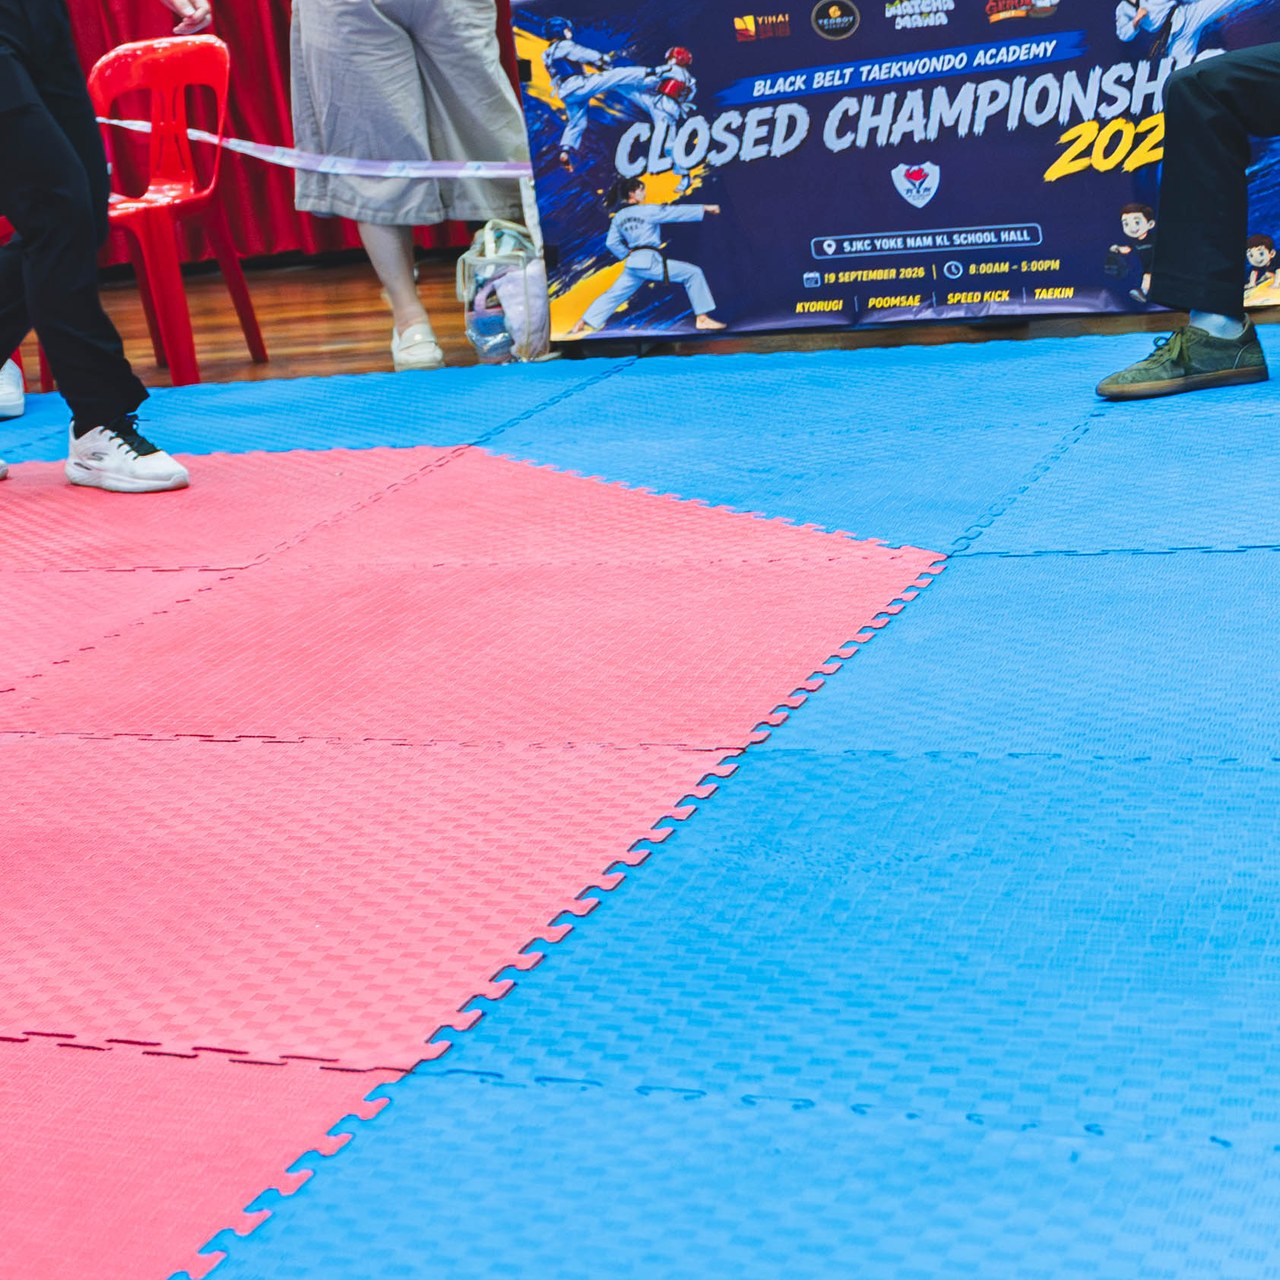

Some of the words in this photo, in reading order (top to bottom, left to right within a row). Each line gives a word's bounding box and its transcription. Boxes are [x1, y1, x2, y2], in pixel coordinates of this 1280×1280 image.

[756, 13, 790, 25] YIHAI
[752, 74, 807, 97] BLACK
[812, 66, 855, 89] BELT
[859, 53, 968, 83] TAEKWONDO
[973, 39, 1058, 66] ACADEMY
[614, 102, 811, 179] CLOSED
[822, 48, 1227, 153] CHAMPIONSH
[843, 238, 872, 253] SJKC
[875, 236, 905, 251] YOKE
[906, 234, 934, 249] NAM
[936, 233, 951, 248] KL
[953, 231, 998, 246] SCHOOL
[1001, 229, 1031, 244] HALL
[1021, 259, 1061, 272] 5:00PM
[823, 272, 837, 284] 19
[838, 268, 897, 283] SEPTEMBER
[946, 291, 981, 304] SPEED
[983, 289, 1010, 302] KICK
[1034, 287, 1074, 301] TAEKIN
[796, 300, 843, 314] KYORUGI
[867, 295, 921, 308] POOMSAE
